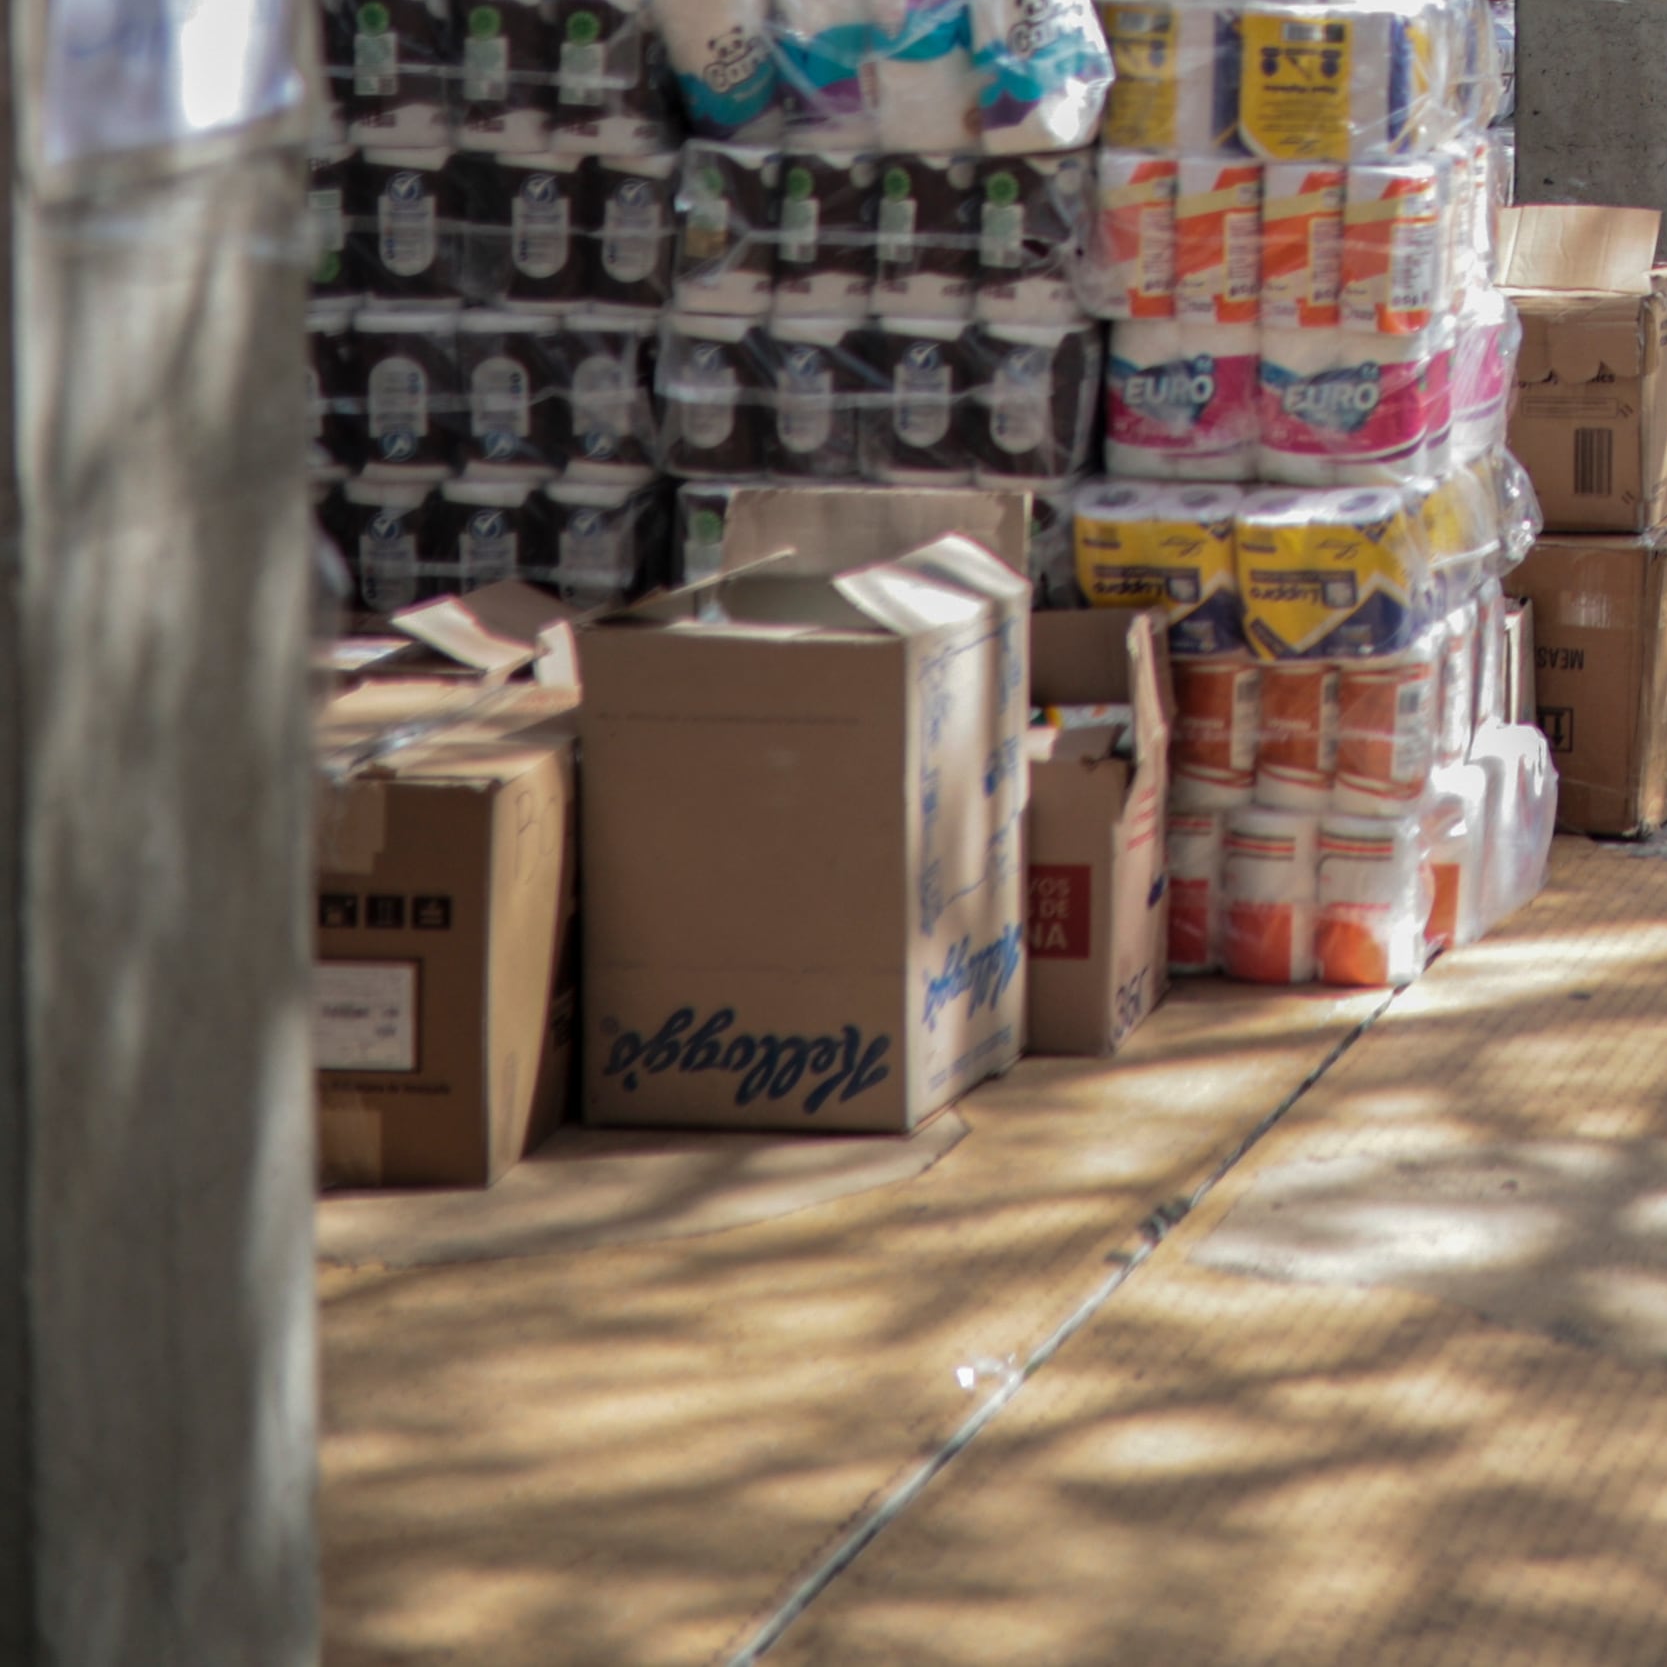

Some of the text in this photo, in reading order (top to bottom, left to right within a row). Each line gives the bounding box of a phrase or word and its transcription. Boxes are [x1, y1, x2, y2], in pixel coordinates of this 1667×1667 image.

[1122, 376, 1215, 405] EURO
[1283, 383, 1381, 414] EURO
[602, 1006, 892, 1114] Kellogg's
